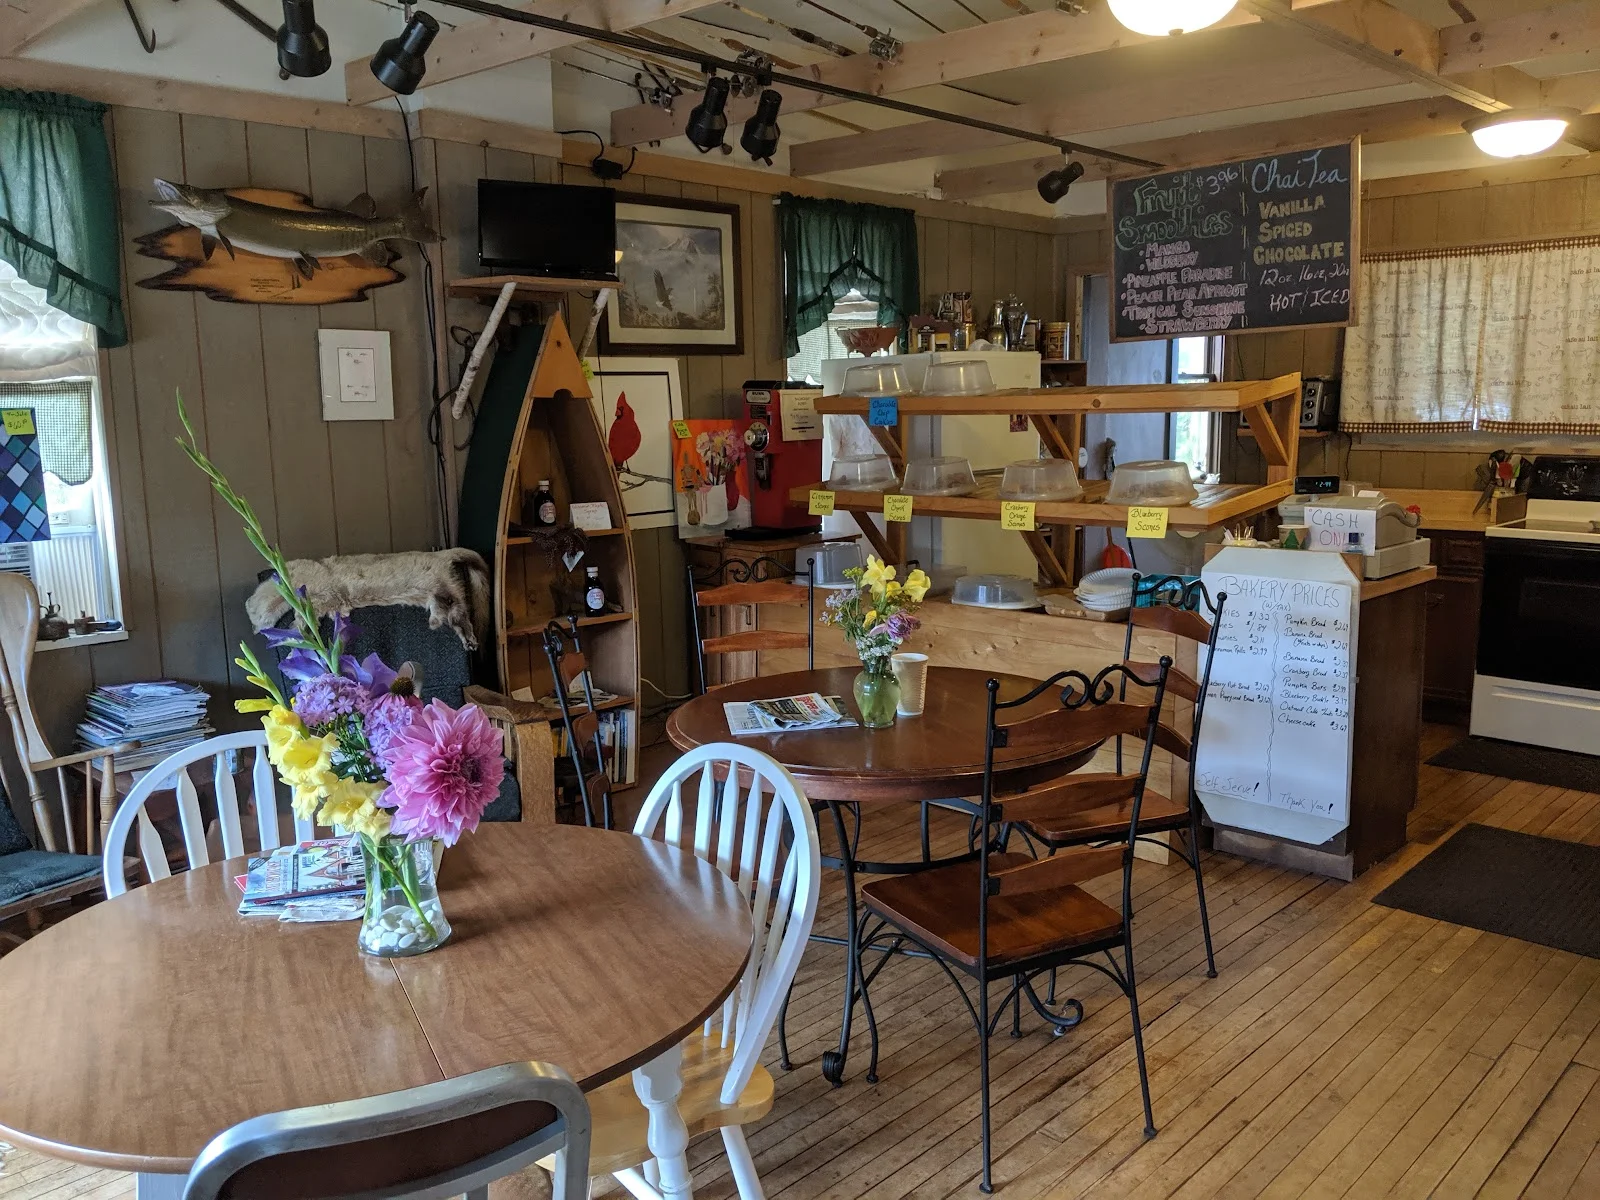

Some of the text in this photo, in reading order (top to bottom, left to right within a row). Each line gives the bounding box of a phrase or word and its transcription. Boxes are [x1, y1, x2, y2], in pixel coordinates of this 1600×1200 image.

[1252, 150, 1347, 193] Chai Tea
[1133, 171, 1201, 216] Fruit
[1259, 195, 1326, 219] VANILLA
[1258, 222, 1312, 243] SPICED
[1146, 240, 1190, 257] MANGO
[1253, 241, 1345, 266] CHOCOLATE
[1146, 251, 1199, 271] WILDBERRY
[1127, 265, 1233, 289] PINEAPPLE PARADISE
[1127, 283, 1248, 305] PEACH PEAR APRICOT
[1270, 293, 1303, 312] HOT
[1310, 288, 1350, 308] ICED
[1124, 299, 1246, 321] TROPICAL SUNSHINE
[1145, 315, 1233, 334] STRAWBERRY
[1130, 507, 1163, 520] Blueberry
[1311, 509, 1359, 528] CASH
[1135, 520, 1161, 532] Scones
[1217, 576, 1341, 609] BAKERY PRICES
[1284, 613, 1308, 627] Pumpkin
[1311, 616, 1327, 627] Bread
[1309, 654, 1326, 664] Bread
[1312, 667, 1328, 677] Bread
[1283, 676, 1308, 690] Pumpkin
[1196, 771, 1260, 798] Self Serve!
[1279, 792, 1334, 815] Thank You!
